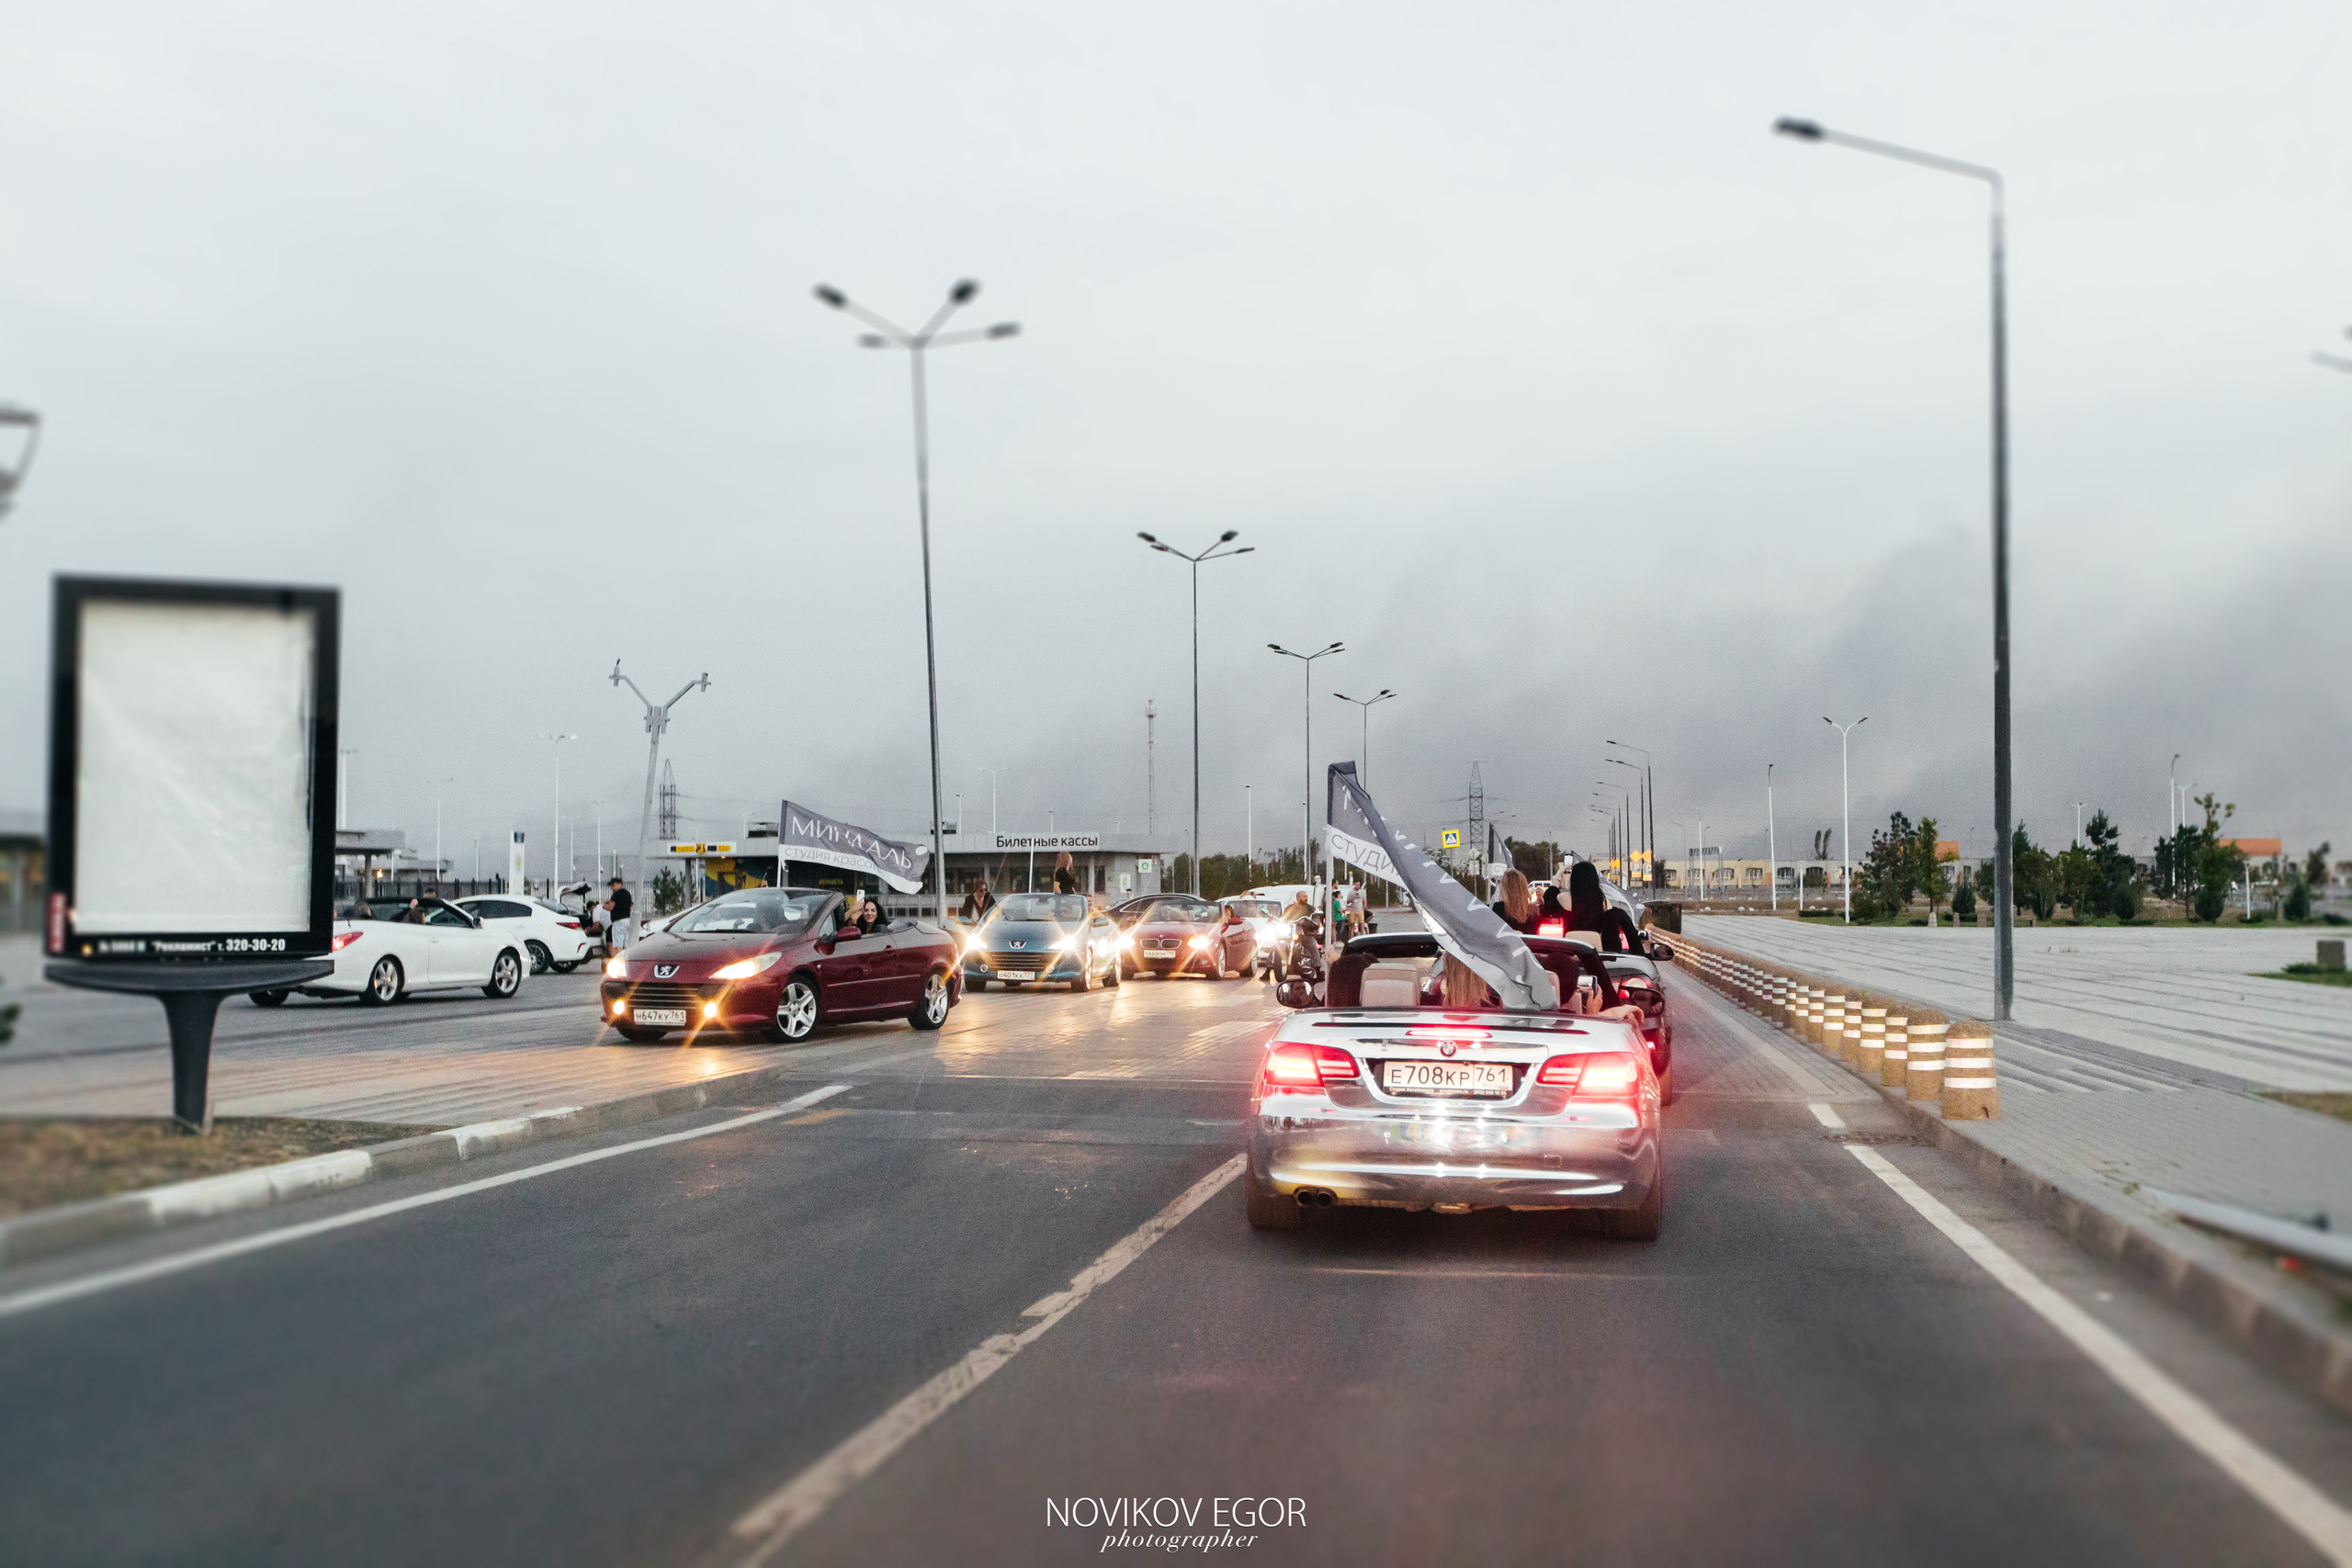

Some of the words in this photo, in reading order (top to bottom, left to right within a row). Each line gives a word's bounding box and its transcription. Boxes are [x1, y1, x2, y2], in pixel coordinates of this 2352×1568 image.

[996, 835, 1058, 848] Билетные
[1061, 836, 1098, 847] кассы
[785, 847, 831, 862] студия
[226, 938, 286, 952] 320-30-20
